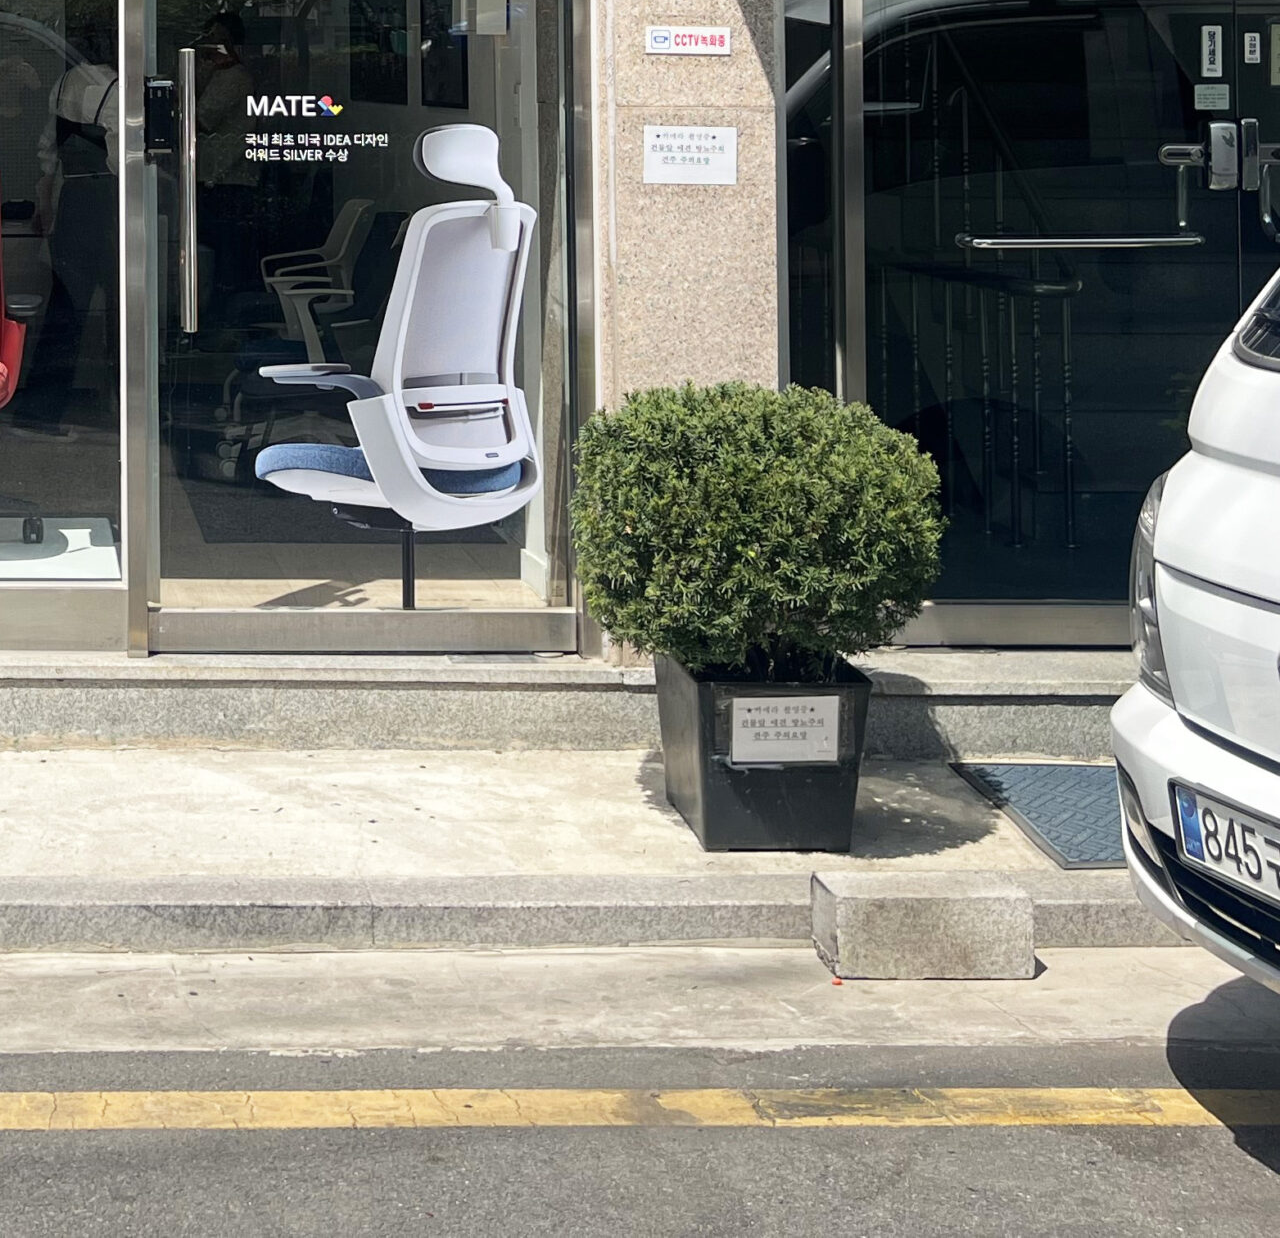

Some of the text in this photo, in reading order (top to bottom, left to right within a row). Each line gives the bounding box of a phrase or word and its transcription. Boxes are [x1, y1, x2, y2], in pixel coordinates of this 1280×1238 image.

[246, 95, 317, 117] MATE
[245, 133, 389, 147] 국내 최초 미국 IDEA 디자인
[245, 148, 348, 162] 어워드 SILVER 수상
